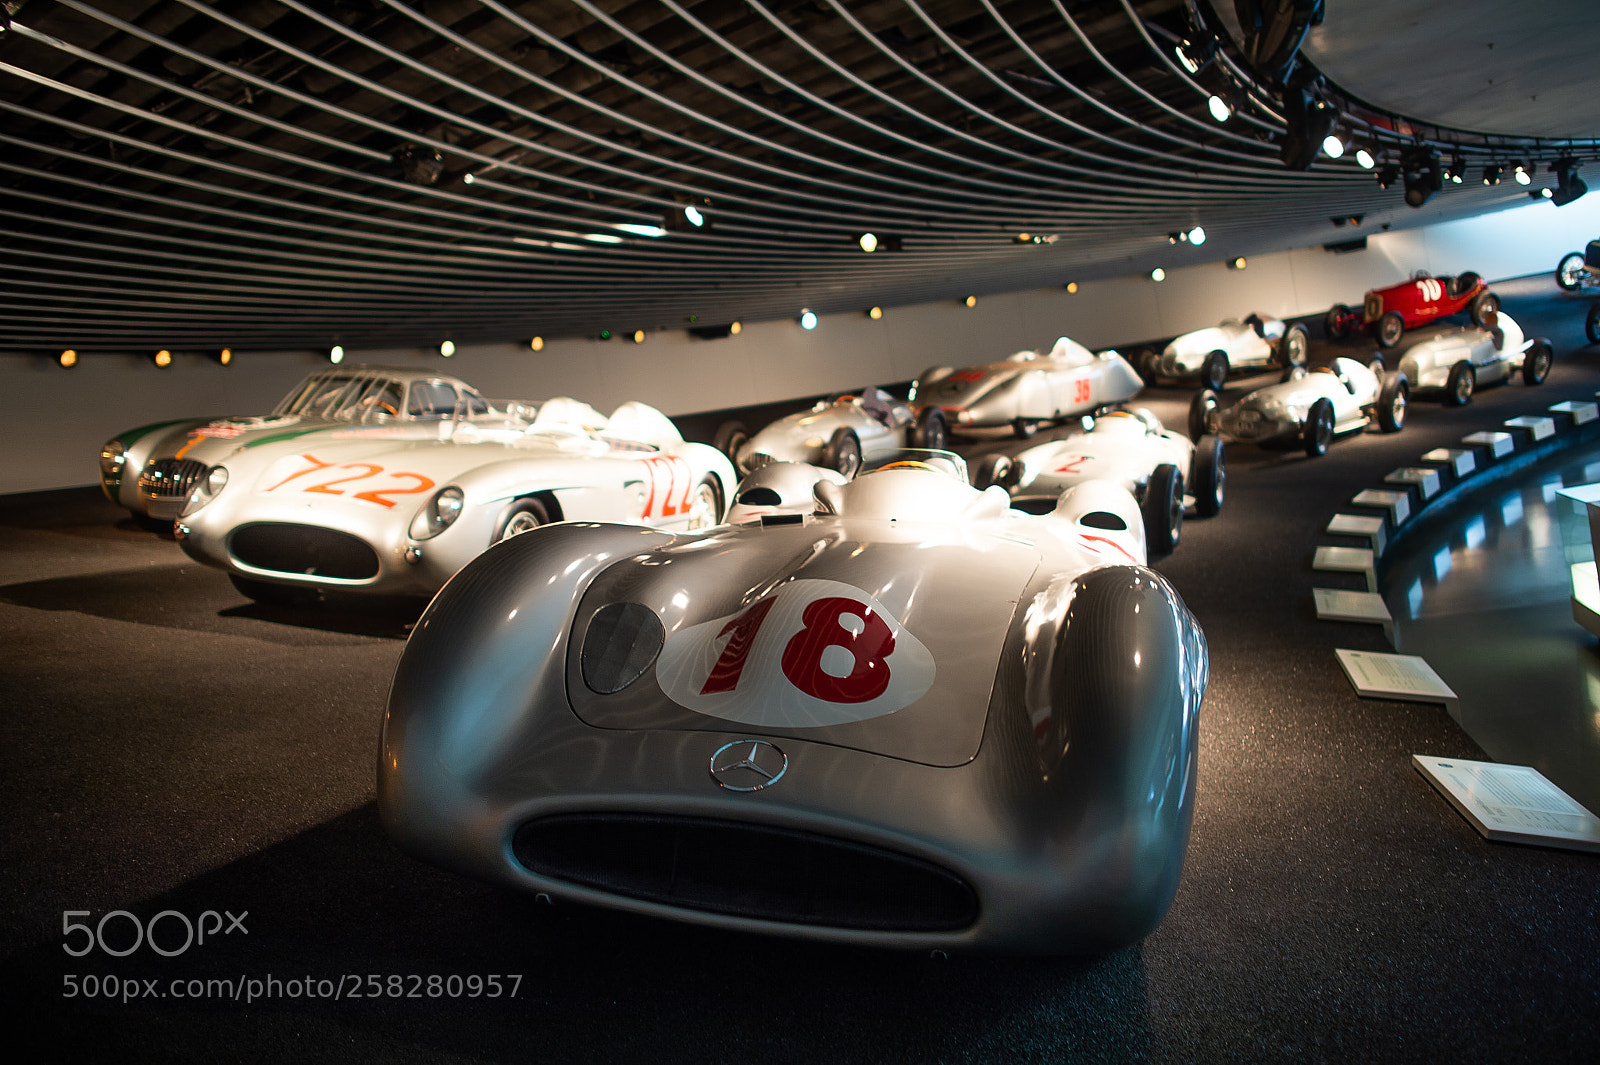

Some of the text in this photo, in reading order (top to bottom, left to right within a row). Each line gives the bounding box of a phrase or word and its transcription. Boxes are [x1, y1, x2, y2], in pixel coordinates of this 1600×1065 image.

[1416, 279, 1441, 302] 10
[266, 453, 436, 508] 722
[700, 595, 896, 703] 18
